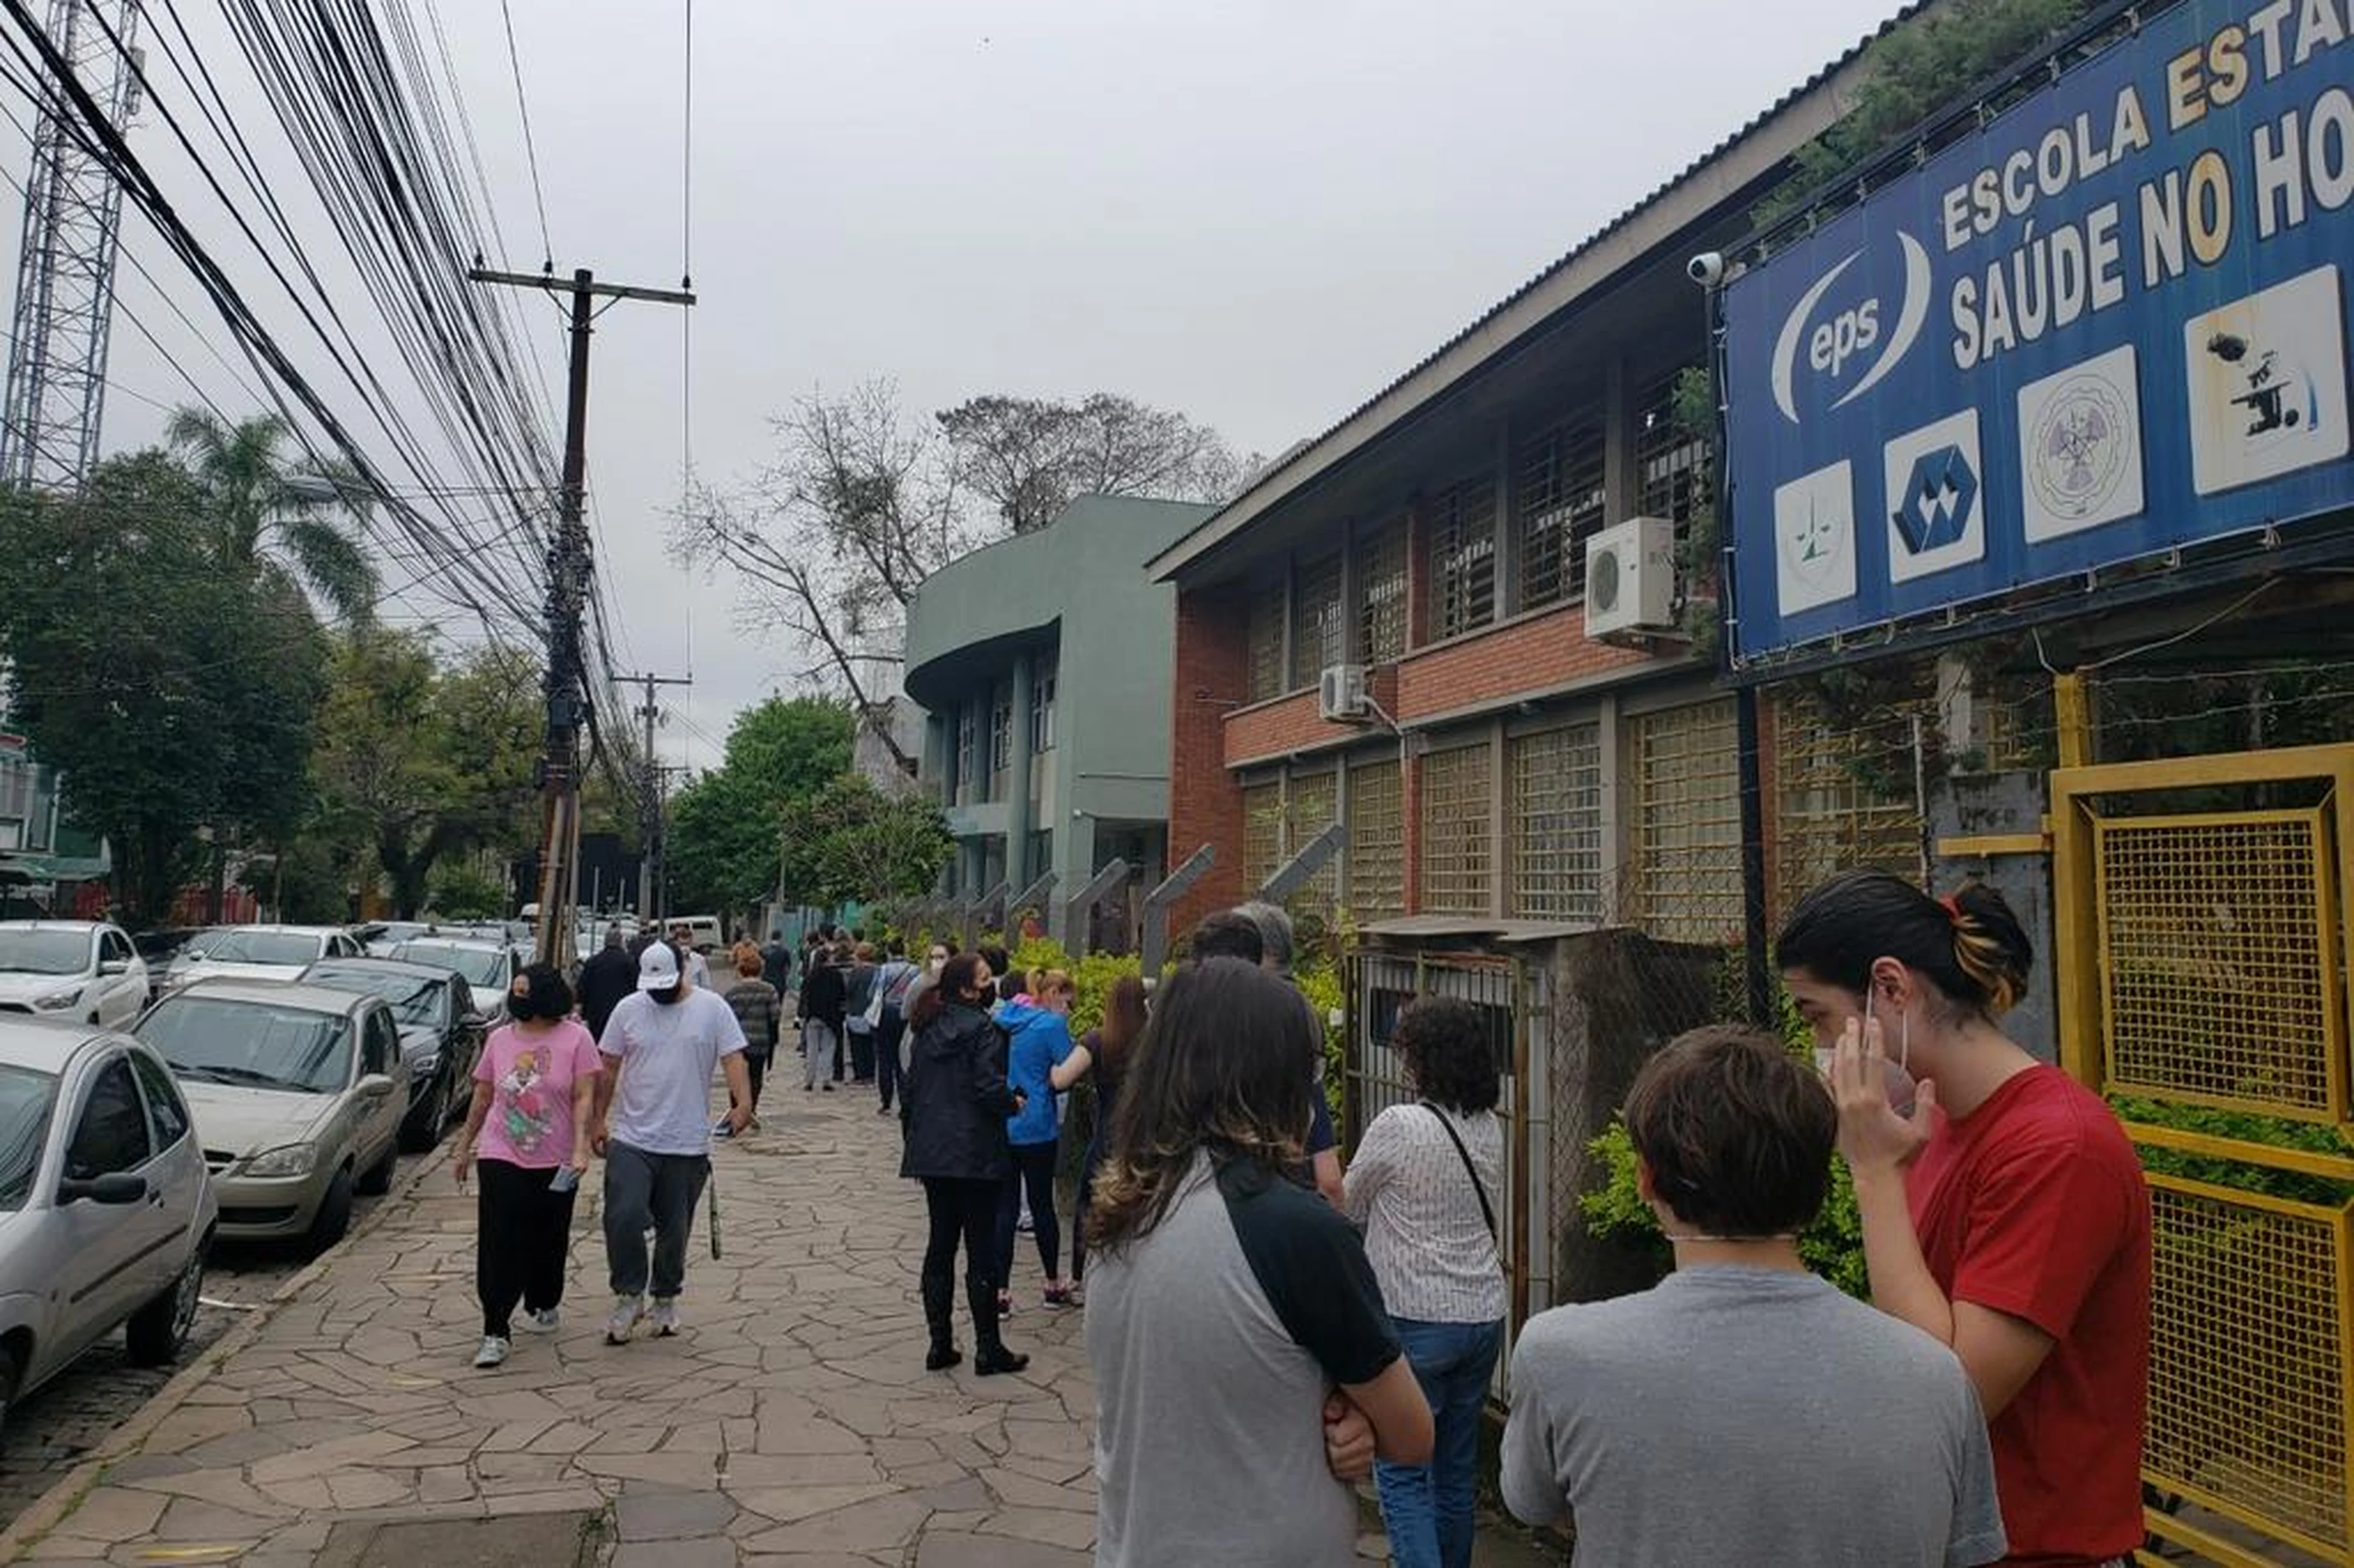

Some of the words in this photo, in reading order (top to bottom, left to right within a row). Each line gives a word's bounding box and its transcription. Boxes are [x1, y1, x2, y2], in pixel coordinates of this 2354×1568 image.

[1943, 85, 2150, 252] ESCOLA
[2167, 0, 2354, 131] ESTA
[1810, 297, 1879, 378] eps
[1951, 202, 2124, 370] SAÚDE
[2139, 150, 2231, 287] NO
